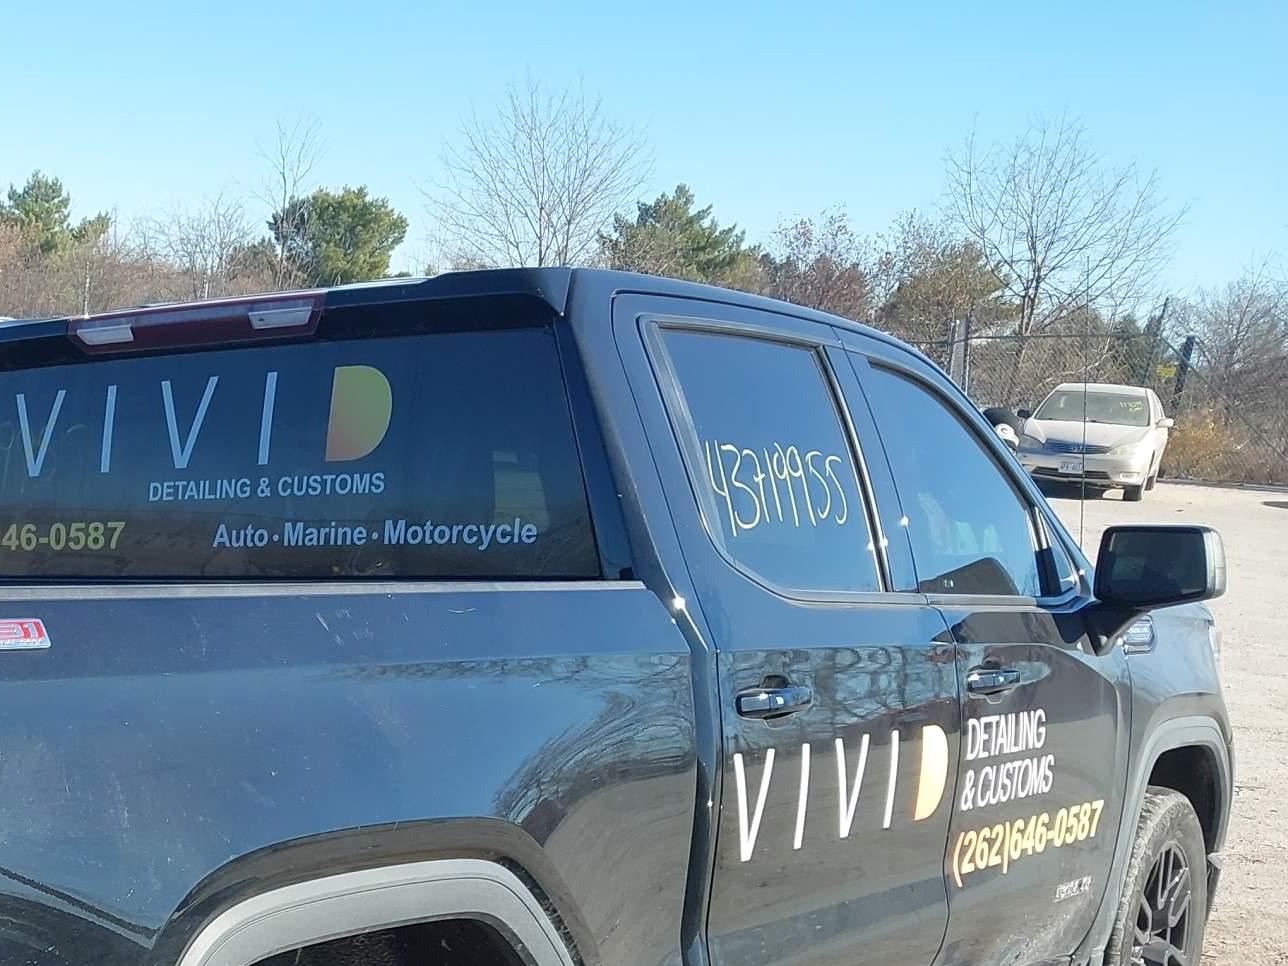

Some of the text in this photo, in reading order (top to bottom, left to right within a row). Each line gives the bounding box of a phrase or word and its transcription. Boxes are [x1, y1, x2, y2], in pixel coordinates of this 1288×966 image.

[16, 365, 393, 477] VIVID
[148, 472, 385, 502] DETAILING & CUSTOMS
[705, 438, 848, 537] 43719955
[212, 518, 538, 551] Auto Marine Motorcycle
[966, 708, 1046, 761] DETAILING
[734, 724, 949, 863] VIVID
[961, 754, 1055, 811] & CUSTOMS
[953, 799, 1104, 888] (262)646-0587
